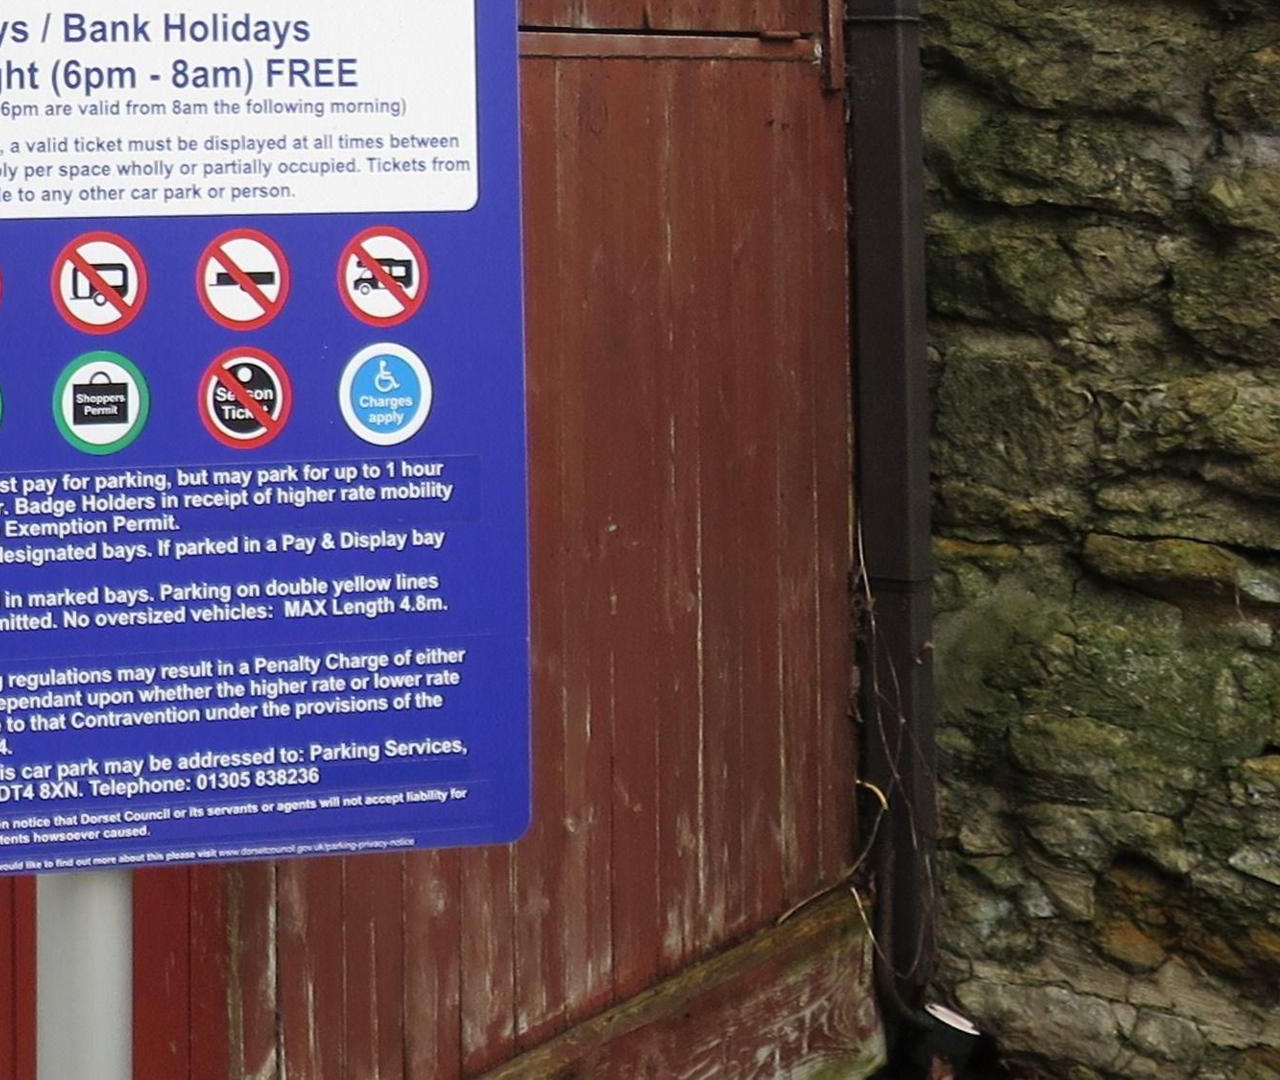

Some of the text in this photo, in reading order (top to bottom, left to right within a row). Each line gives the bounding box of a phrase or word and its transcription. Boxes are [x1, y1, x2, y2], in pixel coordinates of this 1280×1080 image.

[41, 13, 51, 42] /
[63, 13, 150, 42] Bank
[164, 13, 310, 50] Holidays
[51, 59, 136, 97] (6pm
[171, 58, 252, 95] 8am)
[266, 58, 357, 87] FREE
[0, 100, 38, 120] 6pm
[44, 104, 72, 116] are
[78, 100, 120, 115] valid
[125, 99, 166, 115] from
[172, 99, 208, 115] 8am
[213, 99, 240, 114] the
[245, 98, 324, 117] following
[330, 98, 406, 117] morning)
[76, 393, 126, 405] Shoppers
[359, 394, 414, 410] Charges
[84, 405, 118, 416] Permit
[368, 410, 405, 426] apply
[39, 780, 83, 799] 8XN.
[88, 777, 190, 798] Telephone:
[196, 770, 250, 790] 01305
[255, 766, 319, 786] 838236
